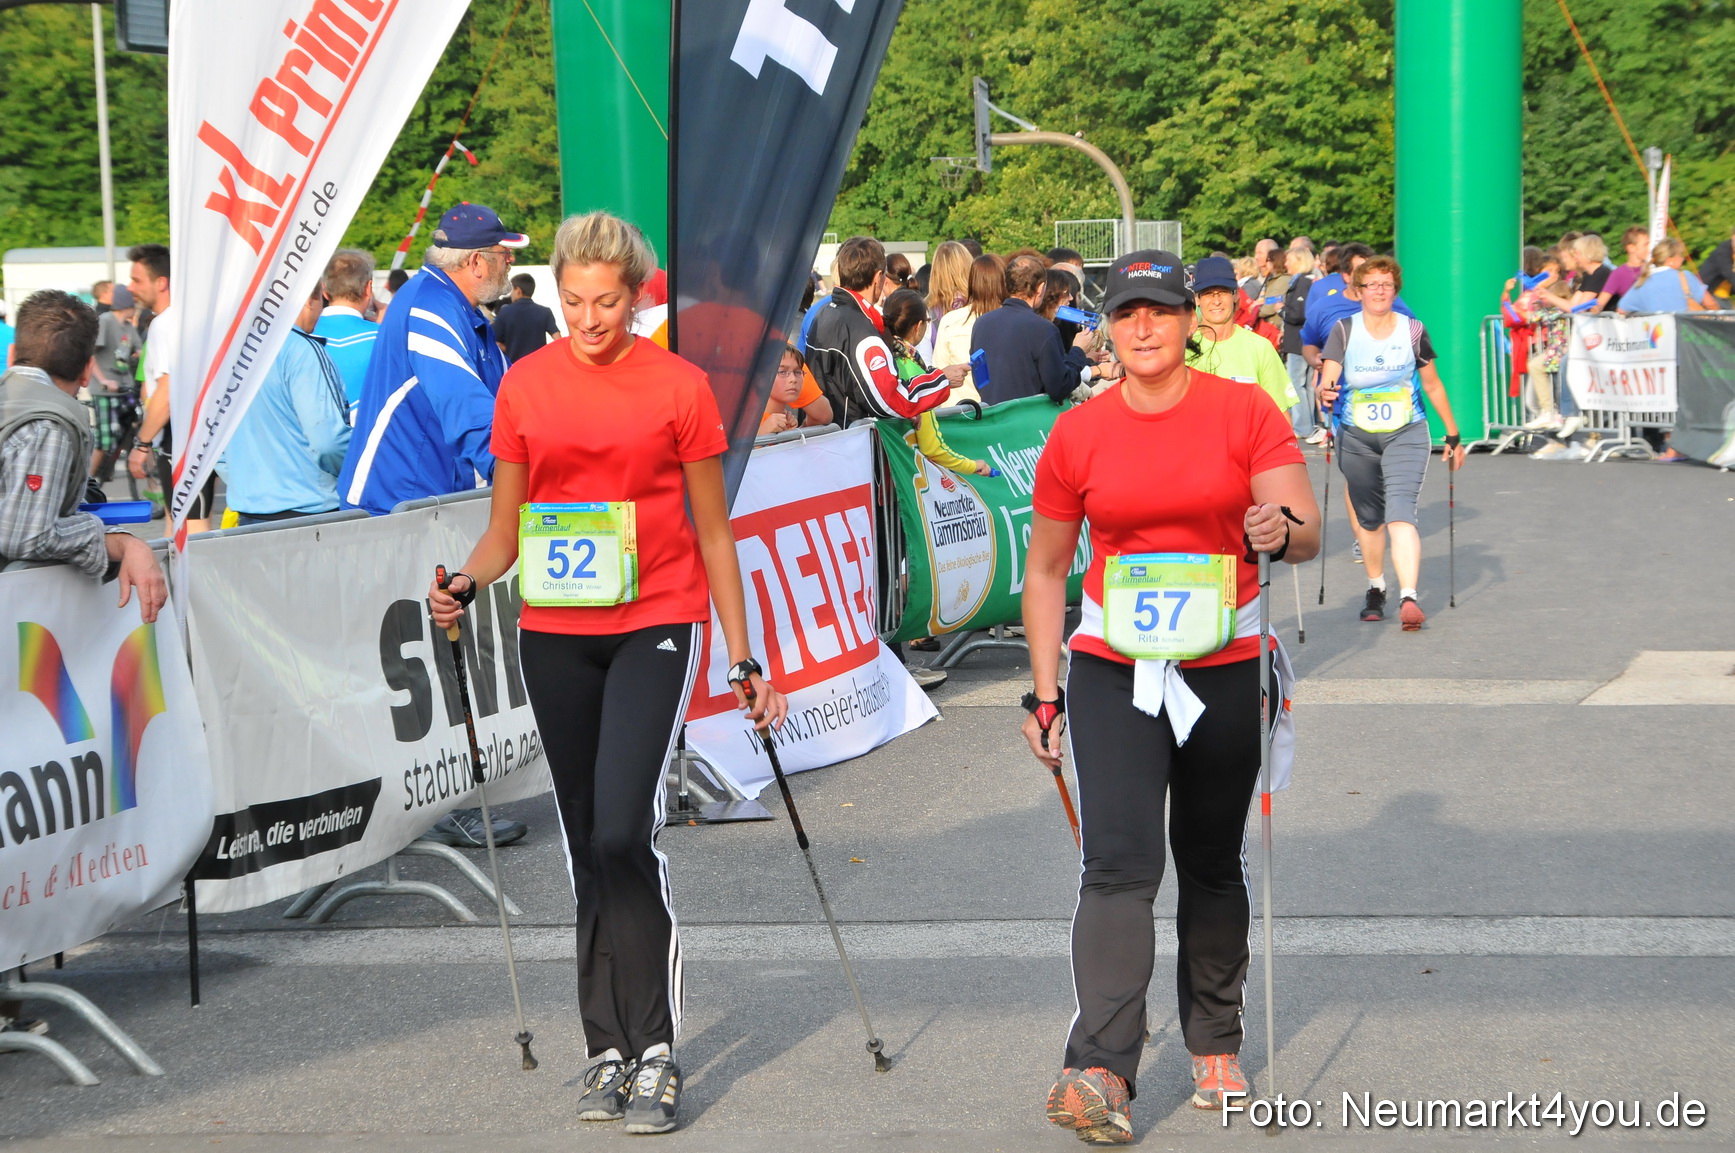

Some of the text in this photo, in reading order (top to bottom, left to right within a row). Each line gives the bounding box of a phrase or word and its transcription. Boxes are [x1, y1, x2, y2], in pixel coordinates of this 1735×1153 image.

[1128, 269, 1162, 279] HACKNER
[1367, 403, 1392, 421] 30
[934, 493, 977, 519] Neumarkter
[930, 512, 988, 548] Lammsbräu
[547, 538, 597, 579] 52
[542, 581, 583, 590] Christina
[1133, 591, 1191, 632] 57
[1138, 634, 1159, 643] Rita
[266, 820, 295, 848] die
[299, 805, 364, 842] verbinden
[65, 842, 149, 890] Medien
